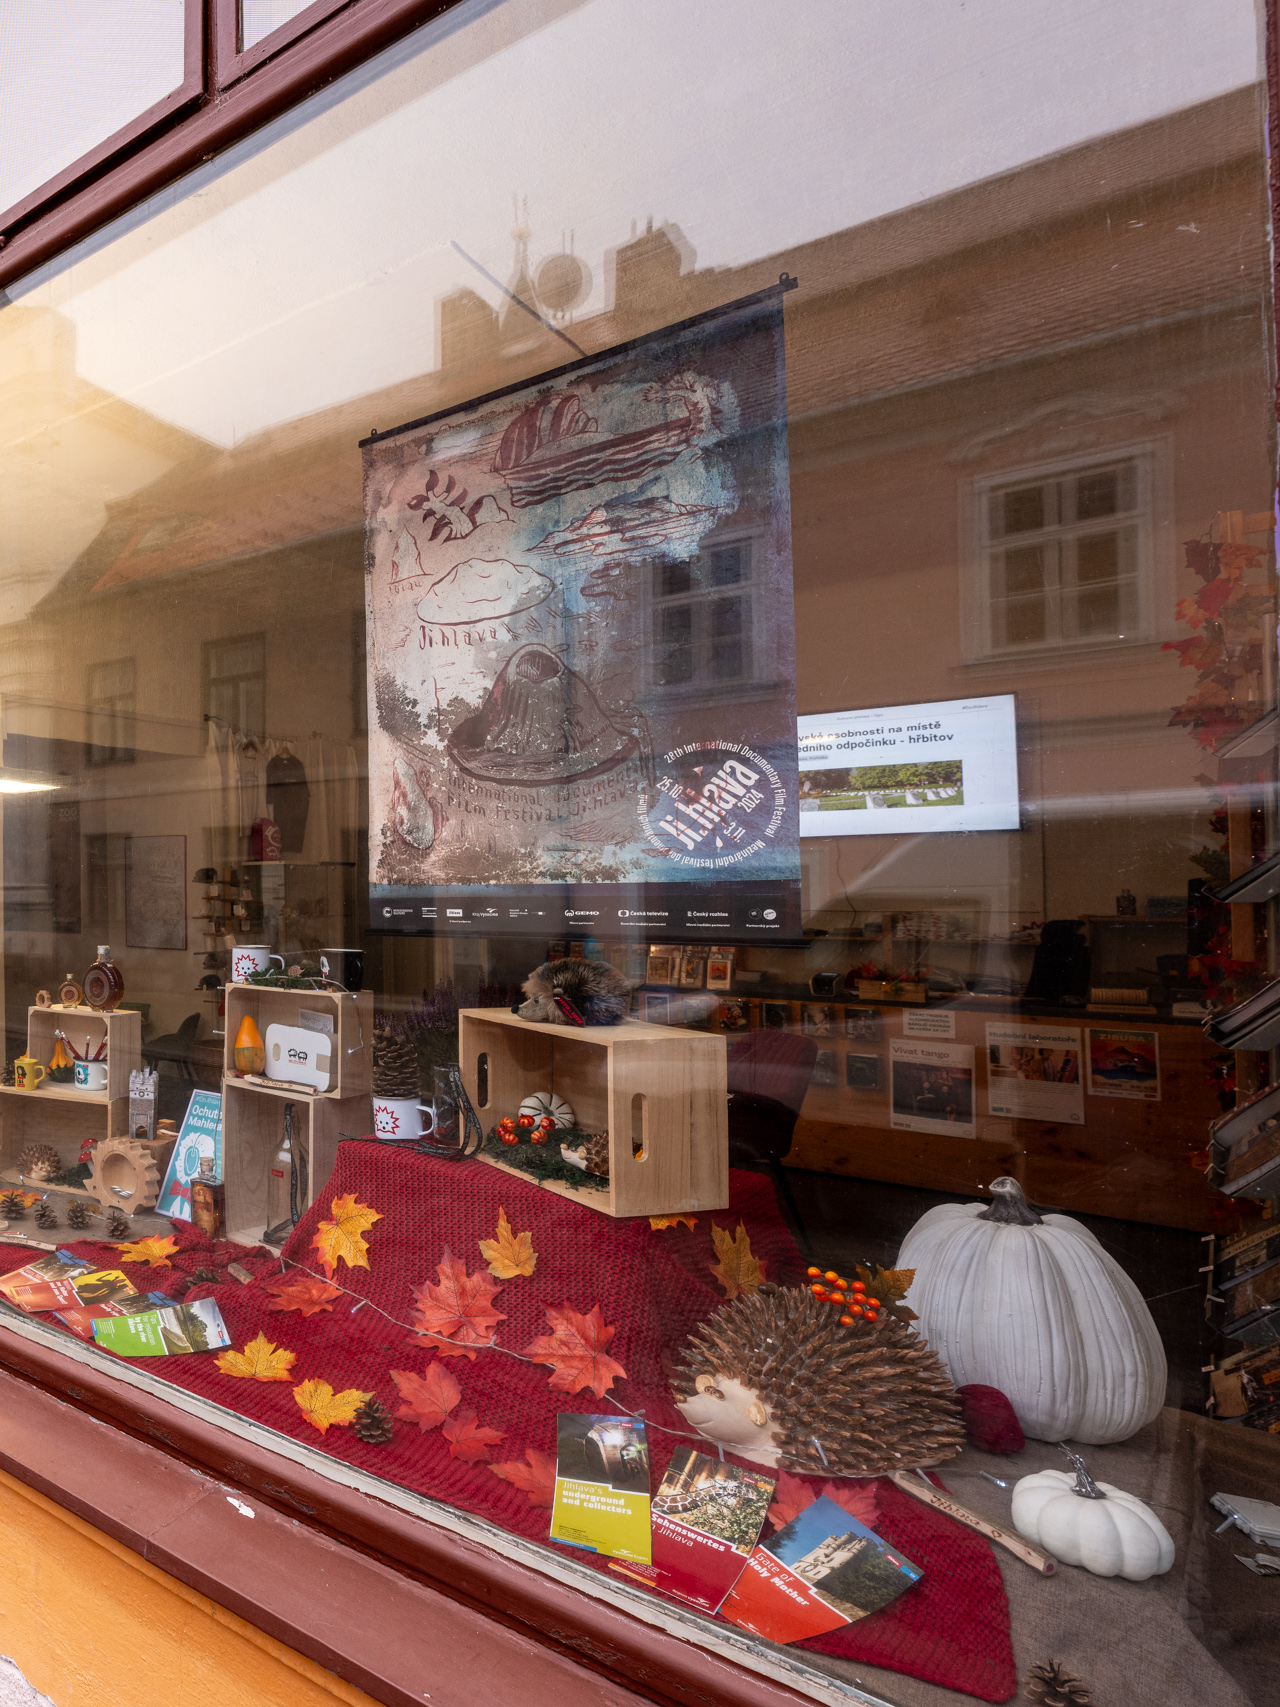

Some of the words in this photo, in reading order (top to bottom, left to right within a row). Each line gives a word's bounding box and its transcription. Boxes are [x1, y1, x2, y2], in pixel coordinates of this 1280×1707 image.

[828, 727, 884, 739] osobnosti
[907, 721, 941, 732] místě
[685, 740, 742, 755] International
[836, 738, 896, 751] odpočinku
[908, 733, 954, 745] hřbitov
[664, 747, 685, 764] 28th
[740, 745, 782, 788] Documentary
[738, 788, 765, 813] 2024
[774, 788, 787, 805] Film
[764, 806, 786, 838] Festival
[681, 855, 714, 869] festival
[715, 839, 767, 868] Mezinárodní
[693, 910, 709, 918] Český
[989, 1031, 1026, 1040] Hudební
[1029, 1034, 1077, 1043] laboratoře
[1099, 1033, 1146, 1043] ZIBURA
[893, 1046, 918, 1056] Vivat
[921, 1049, 950, 1059] tango
[141, 1314, 149, 1323] for
[149, 1313, 158, 1325] Tips
[138, 1330, 147, 1343] river
[143, 1322, 156, 1346] relaxation
[563, 1481, 603, 1495] Jihlava's
[562, 1497, 580, 1506] and
[583, 1501, 632, 1515] collectors
[563, 1490, 625, 1506] underground
[930, 1494, 980, 1526] Jihlava
[651, 1513, 726, 1552] Sehenswertes
[658, 1526, 694, 1548] Jihlava
[755, 1552, 780, 1574] Gate
[780, 1573, 795, 1583] of
[747, 1558, 772, 1578] Holy
[770, 1576, 810, 1607] Mother
